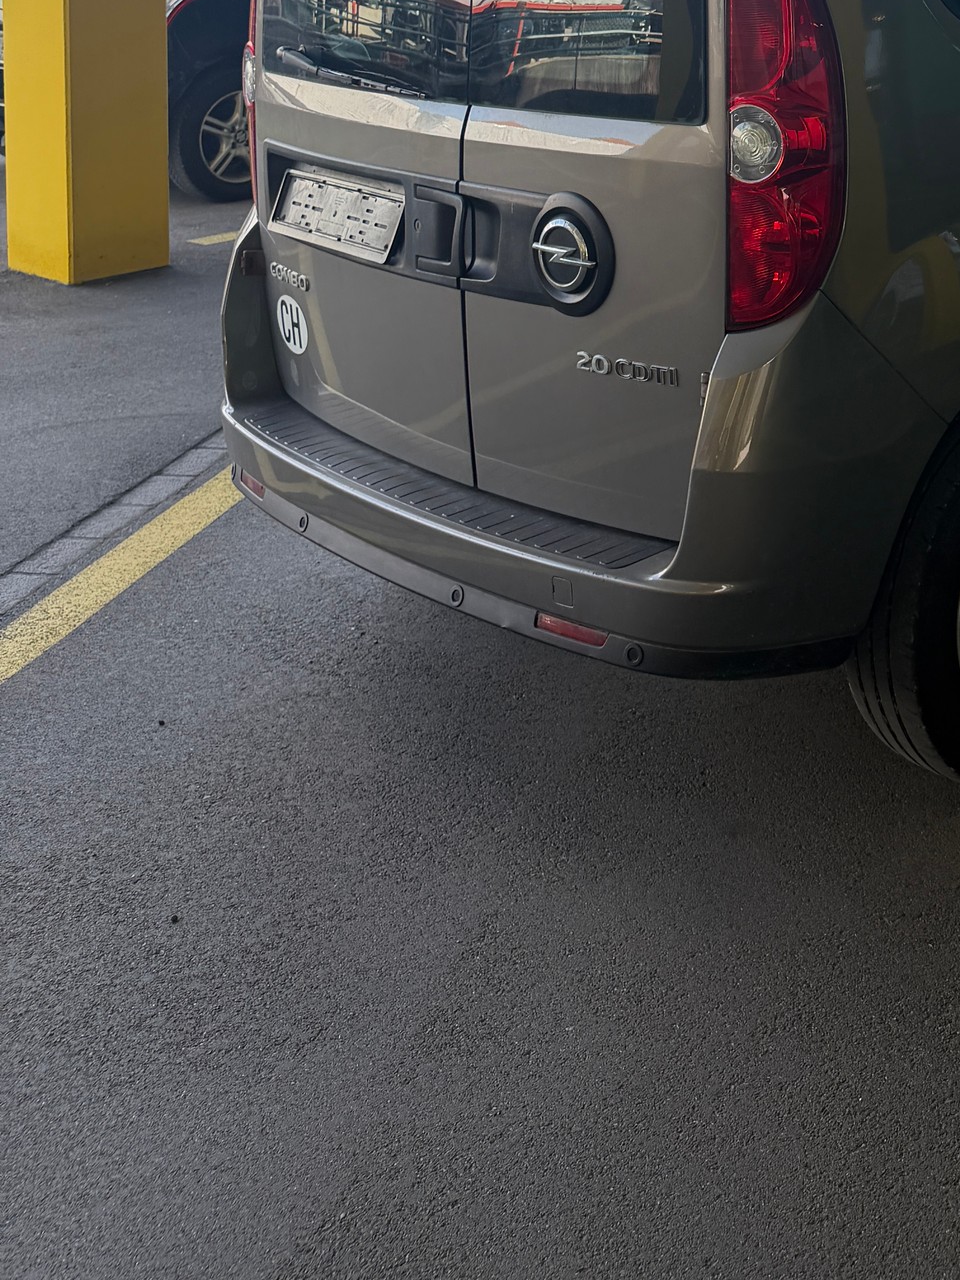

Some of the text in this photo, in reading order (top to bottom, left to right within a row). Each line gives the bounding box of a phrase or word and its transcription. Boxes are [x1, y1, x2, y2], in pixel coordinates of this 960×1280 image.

[270, 261, 310, 292] COMBO
[280, 299, 303, 349] CH
[614, 358, 679, 387] CDTI
